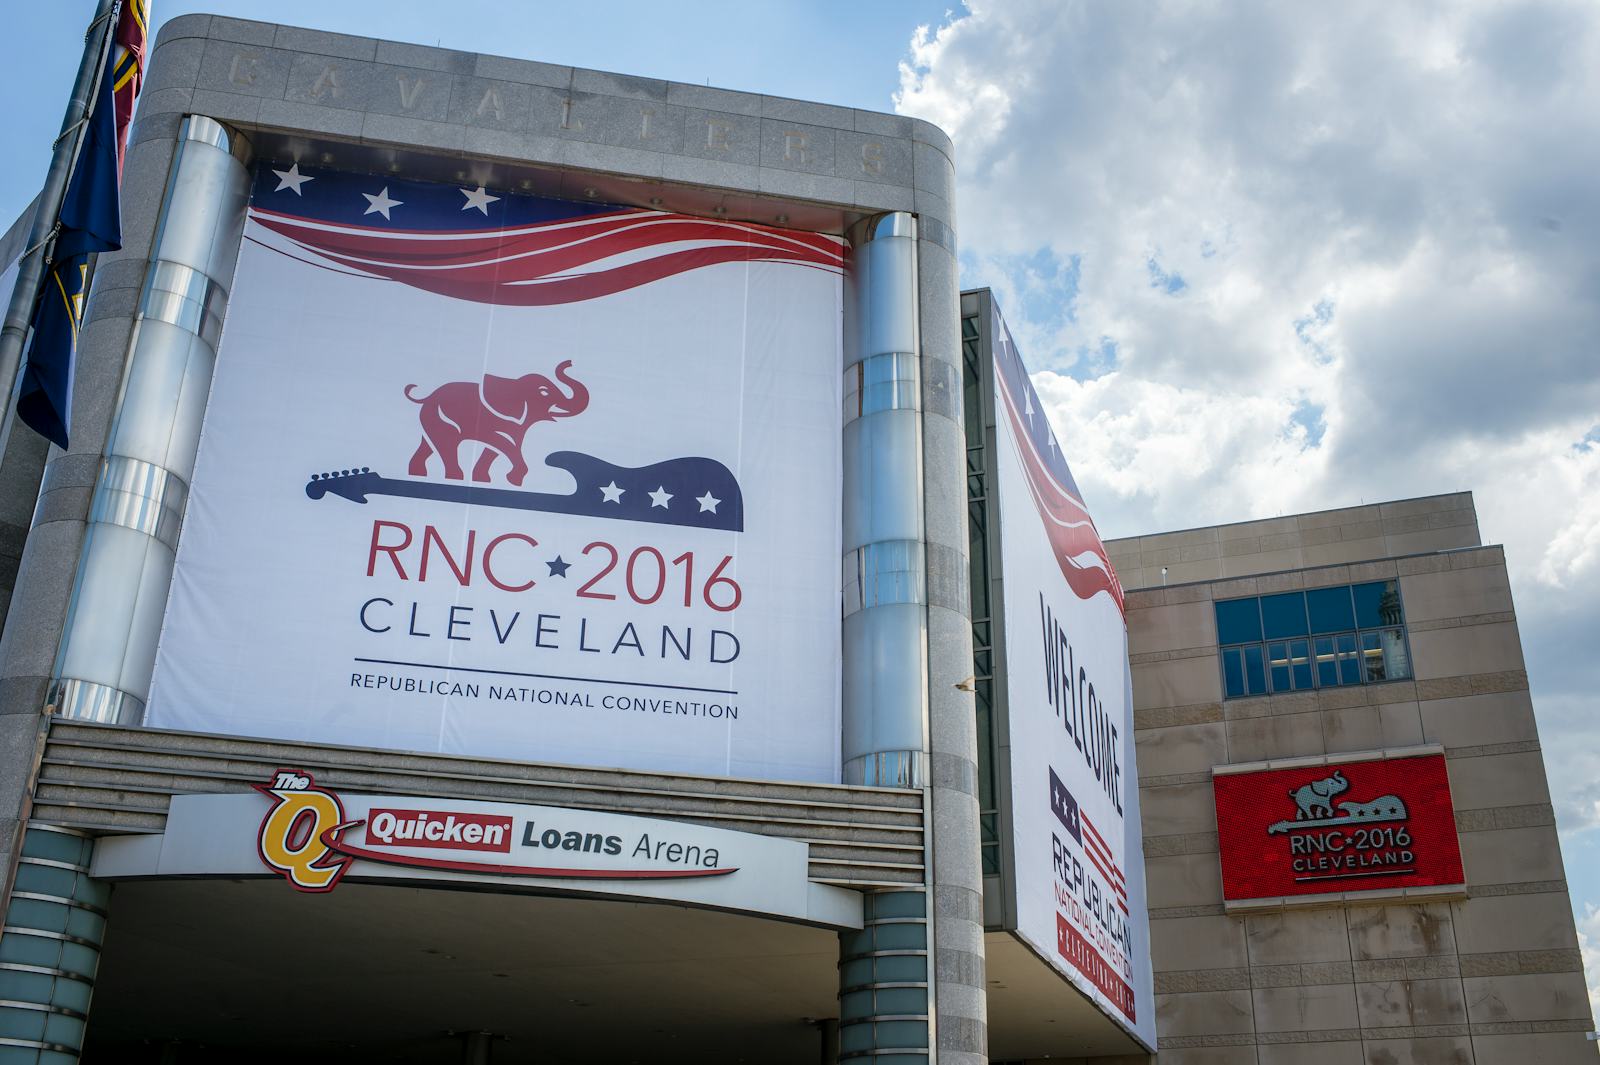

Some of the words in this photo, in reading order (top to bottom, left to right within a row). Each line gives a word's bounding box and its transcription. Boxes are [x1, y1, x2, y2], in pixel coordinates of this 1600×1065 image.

[366, 519, 539, 593] RNC
[576, 541, 742, 612] 2016
[360, 597, 741, 664] CLEVELAND
[350, 672, 480, 699] REPUBLICAN
[489, 685, 595, 708] NATIONAL
[602, 695, 739, 720] CONVENTION
[1039, 590, 1123, 819] WELCOME
[273, 771, 311, 791] The
[260, 788, 349, 889] Q
[521, 820, 623, 856] Loans
[631, 832, 720, 868] Arena
[1290, 831, 1345, 855] RNC
[1354, 826, 1412, 850] 2016
[1293, 850, 1414, 872] CLEVELAND
[1052, 831, 1133, 960] REPUBLICAN
[1054, 879, 1095, 939] NATIONAL
[1095, 924, 1134, 984] CONVENTION
